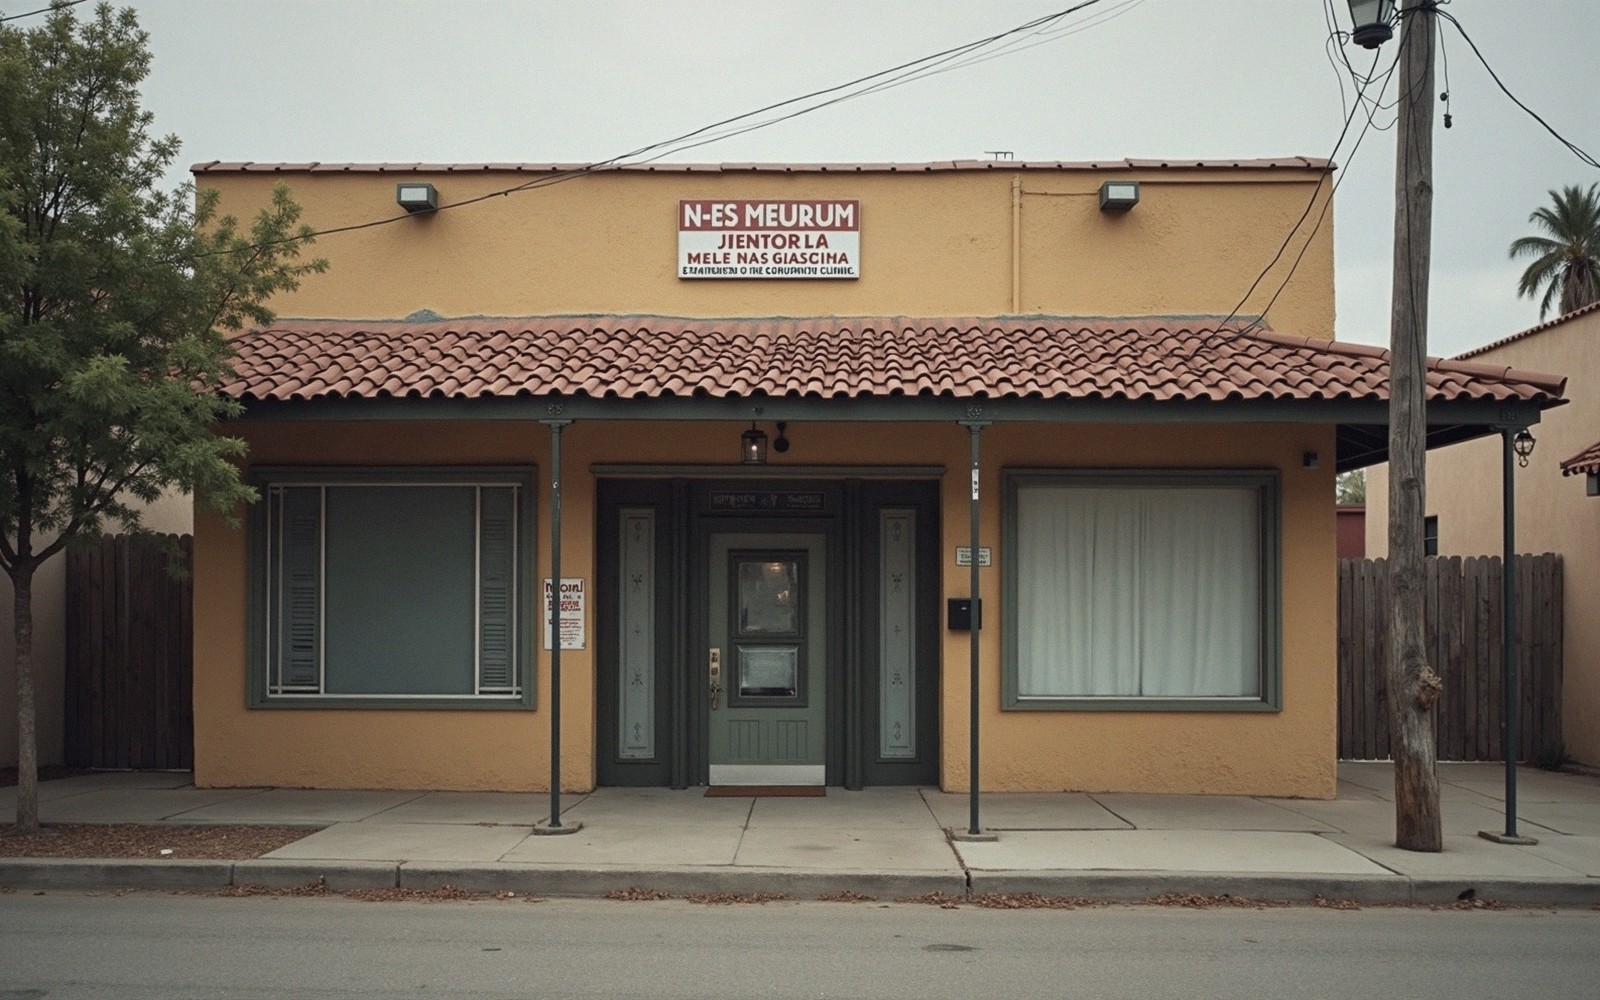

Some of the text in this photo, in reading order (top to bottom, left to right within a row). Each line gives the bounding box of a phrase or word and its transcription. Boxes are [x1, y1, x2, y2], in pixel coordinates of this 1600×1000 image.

[684, 203, 854, 228] N-ES MEURUM
[687, 252, 731, 265] MELE
[737, 252, 769, 265] NAS
